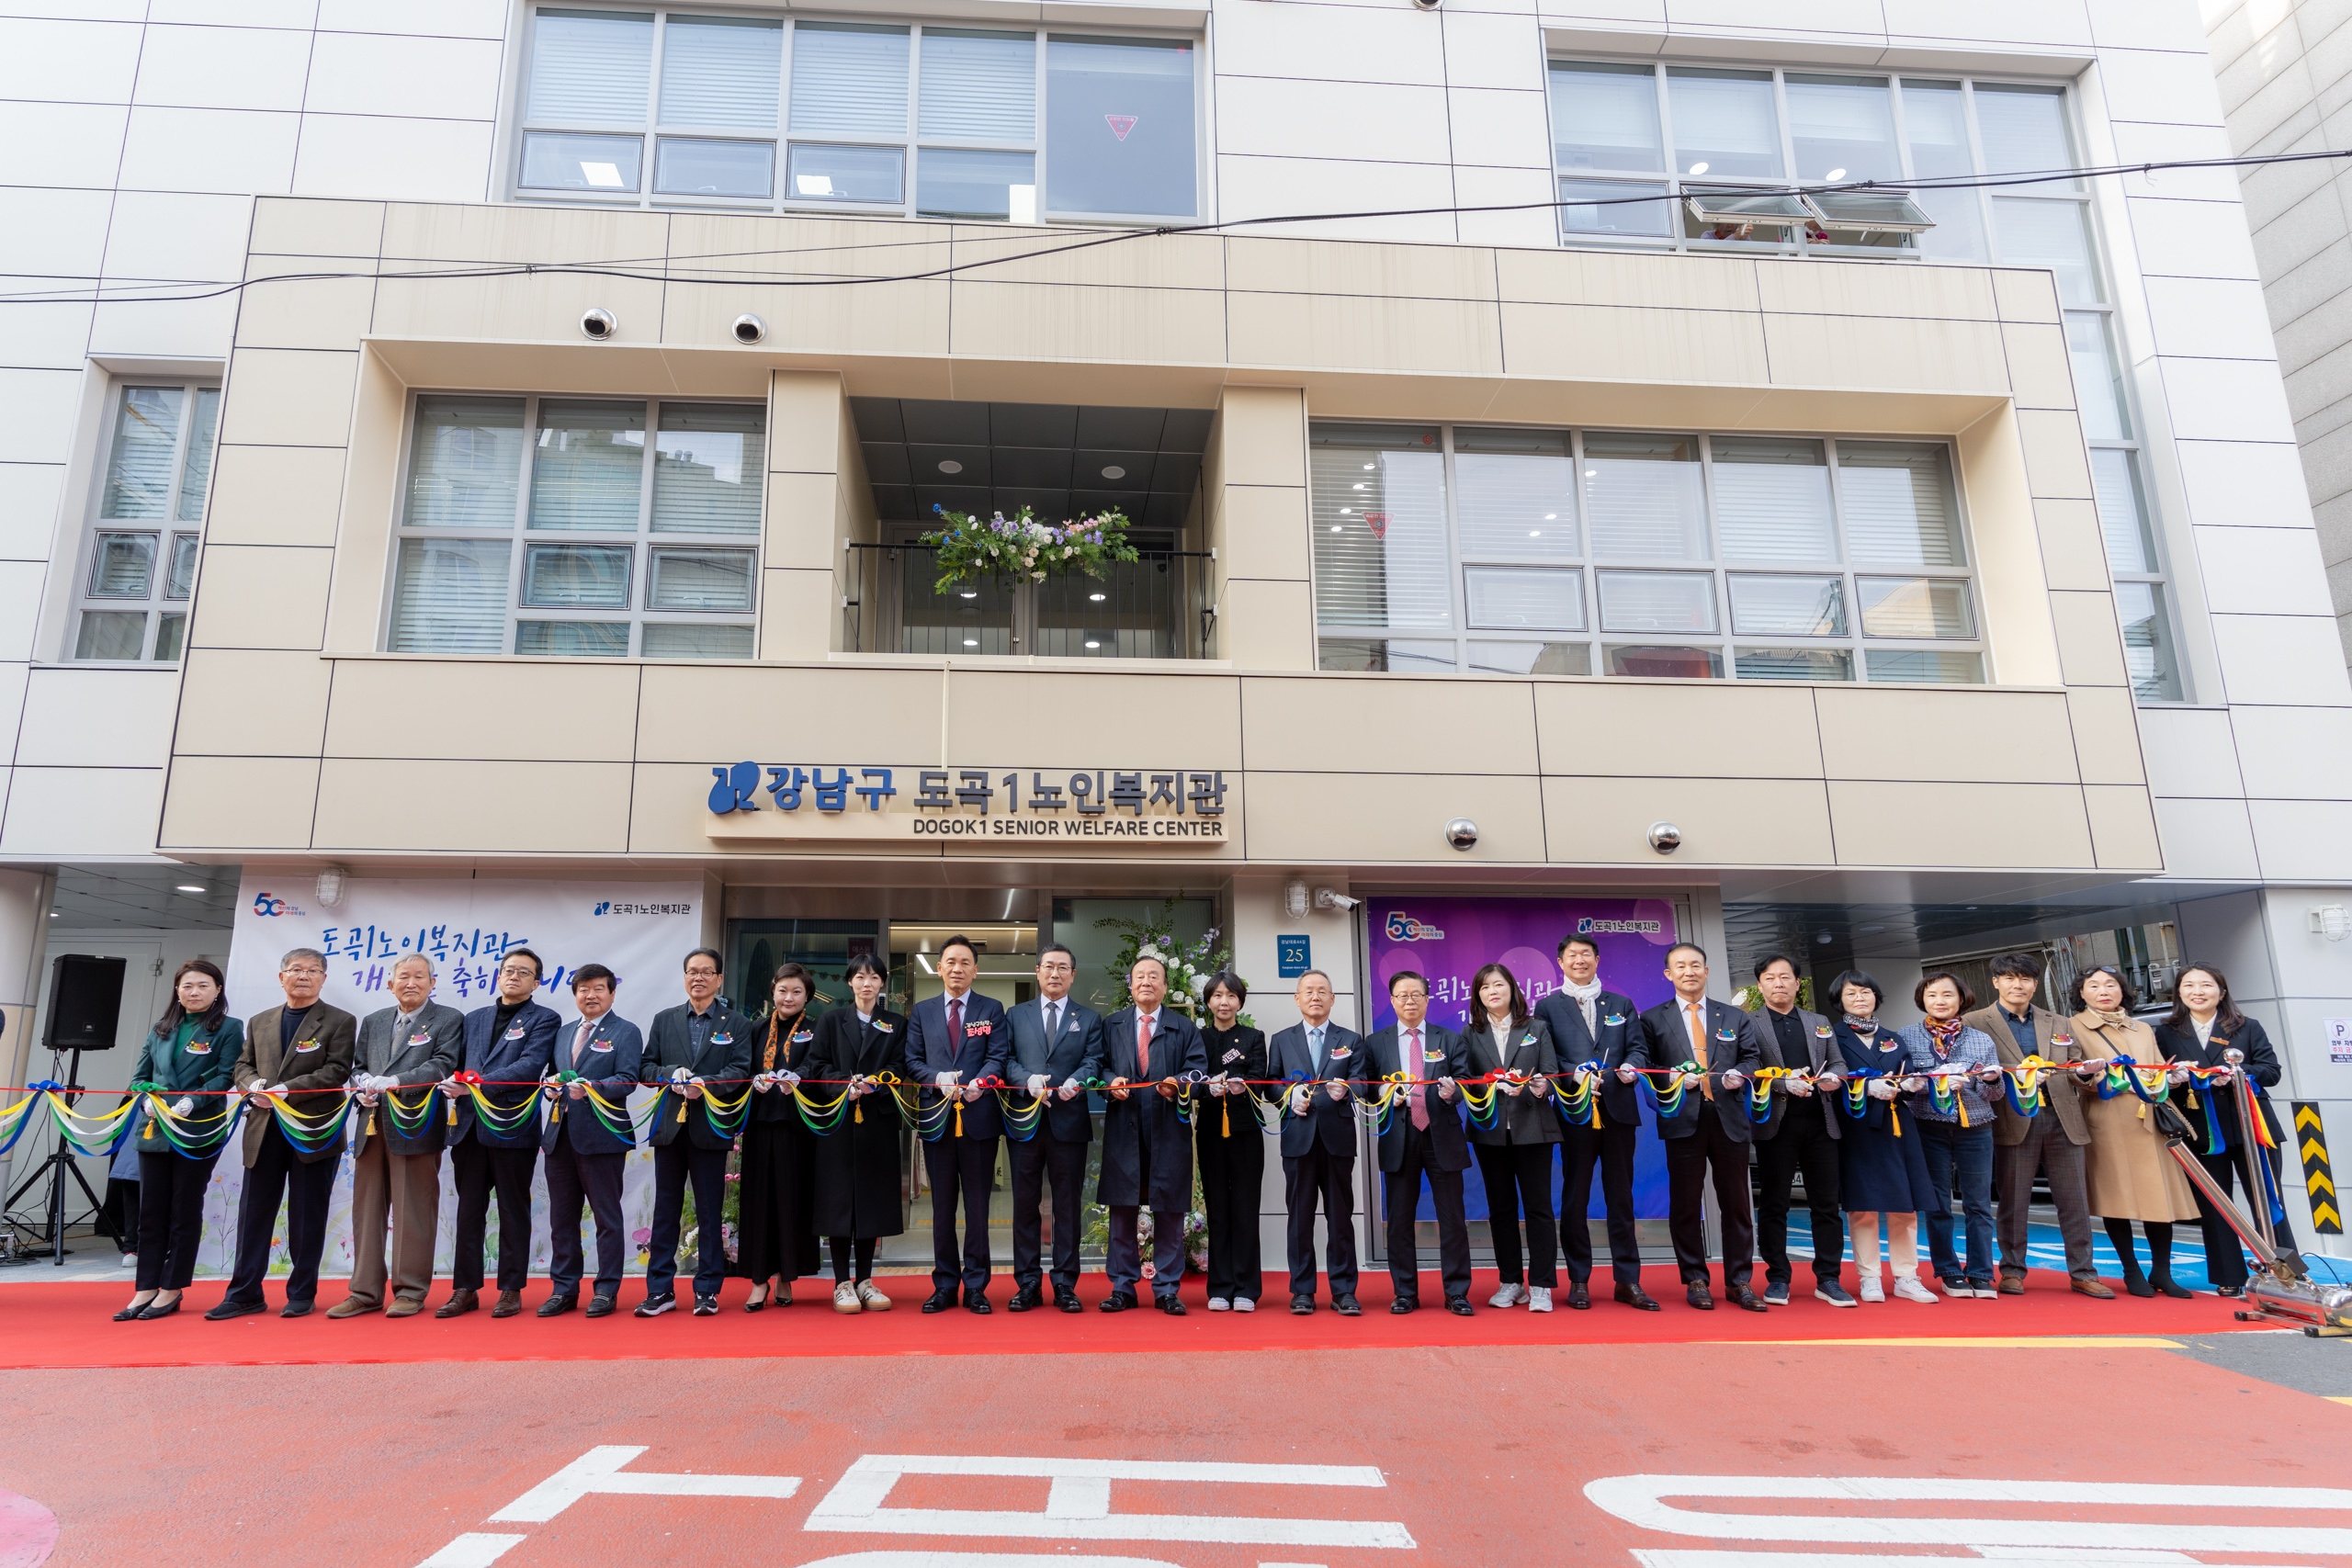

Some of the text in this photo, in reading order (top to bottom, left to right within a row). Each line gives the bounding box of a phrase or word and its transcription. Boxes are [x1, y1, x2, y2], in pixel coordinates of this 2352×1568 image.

[766, 767, 1227, 816] 강남구 도곡1노인복지관
[913, 818, 1223, 837] DOGOK1 SENIOR WELFARE CENTER
[613, 904, 691, 915] 도곡1노인복지관
[1595, 920, 1659, 931] 도곡1노인복지관
[1285, 948, 1304, 962] 25
[2335, 1024, 2346, 1037] P
